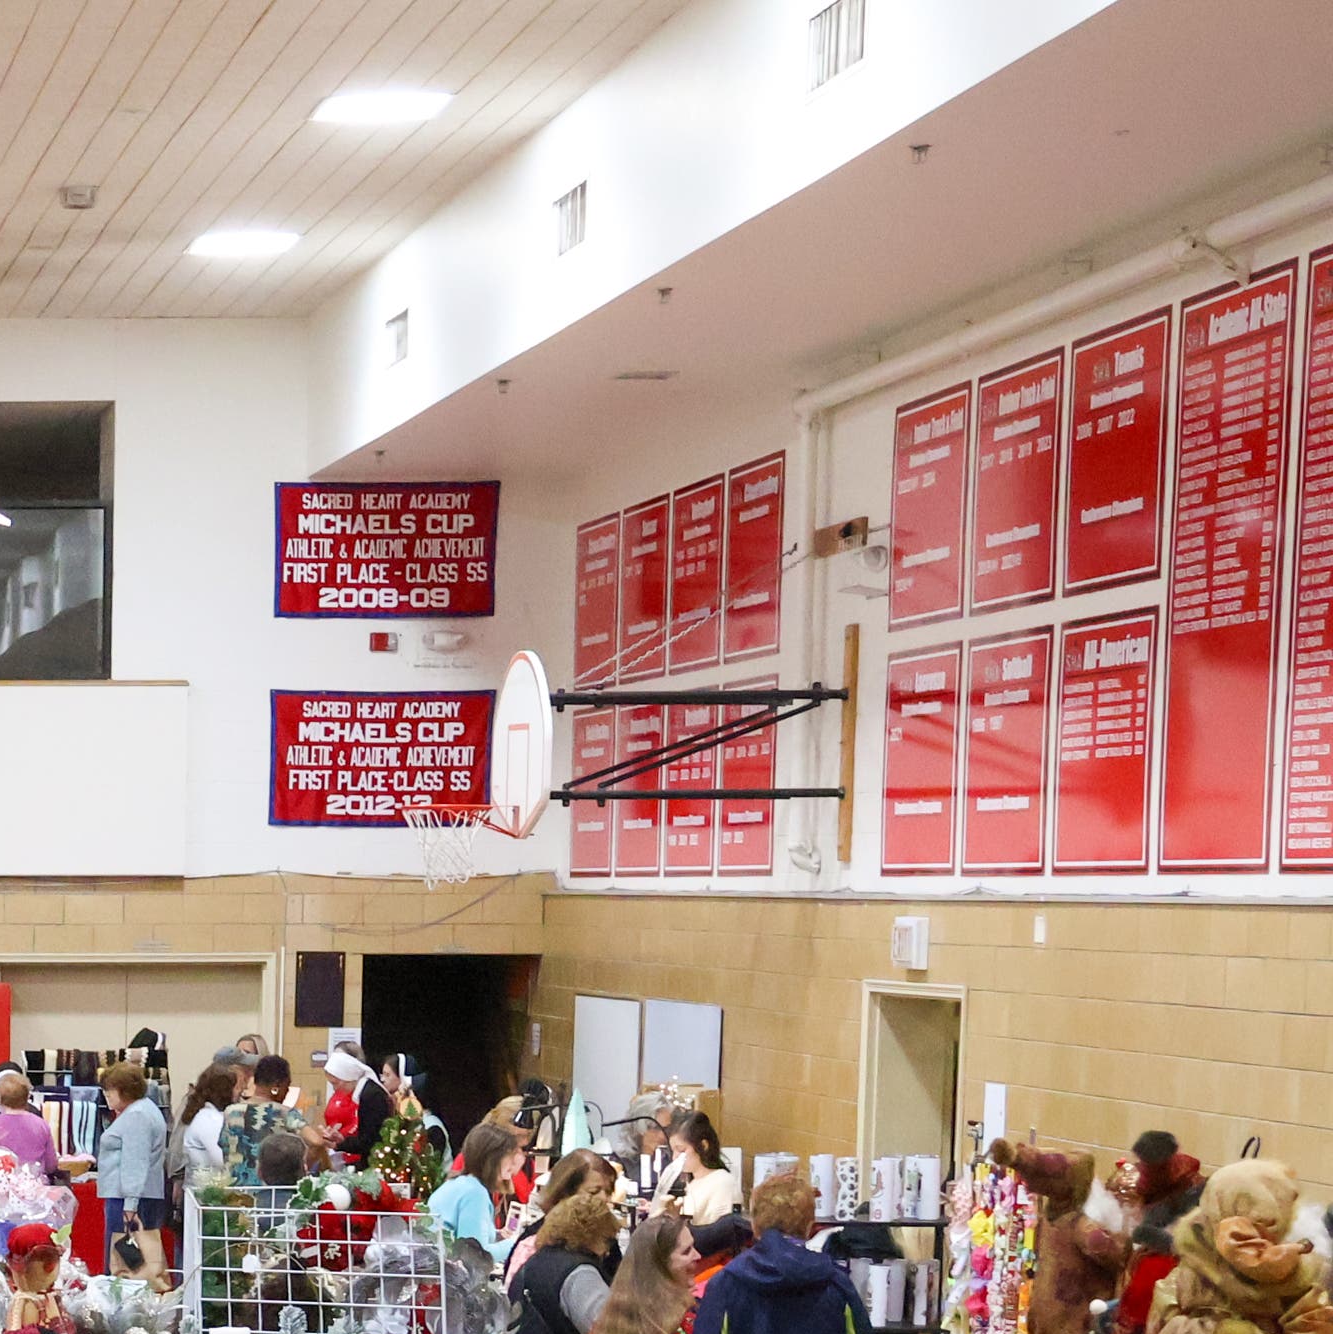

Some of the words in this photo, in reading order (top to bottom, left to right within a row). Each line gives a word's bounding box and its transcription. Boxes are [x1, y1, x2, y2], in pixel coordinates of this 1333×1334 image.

[302, 493, 352, 509] SACRED
[361, 494, 402, 510] HEART
[409, 492, 470, 509] ACADEMY
[298, 515, 416, 534] MICHAELS
[426, 514, 474, 533] CUP
[286, 538, 333, 559] ATHLETIC
[340, 543, 347, 558] &
[353, 538, 407, 558] ACADEMIC
[414, 537, 484, 558] ACHIEVEMENT
[282, 563, 327, 584] FIRST
[337, 564, 389, 584] PLACE
[406, 562, 457, 583] CLASS
[467, 562, 487, 582] SS
[319, 588, 449, 608] 2008-09
[302, 702, 351, 719] SACRED
[357, 702, 397, 718] HEART
[403, 701, 461, 718] ACADEMY
[299, 723, 412, 742] MICHAELS
[417, 722, 465, 742] CUP
[286, 746, 333, 765] ATHLETIC
[337, 752, 345, 766] &
[350, 747, 401, 767] ACADEMIC
[407, 746, 475, 767] ACHIEVEMENT
[289, 770, 333, 791] FIRST
[450, 771, 470, 790] SS
